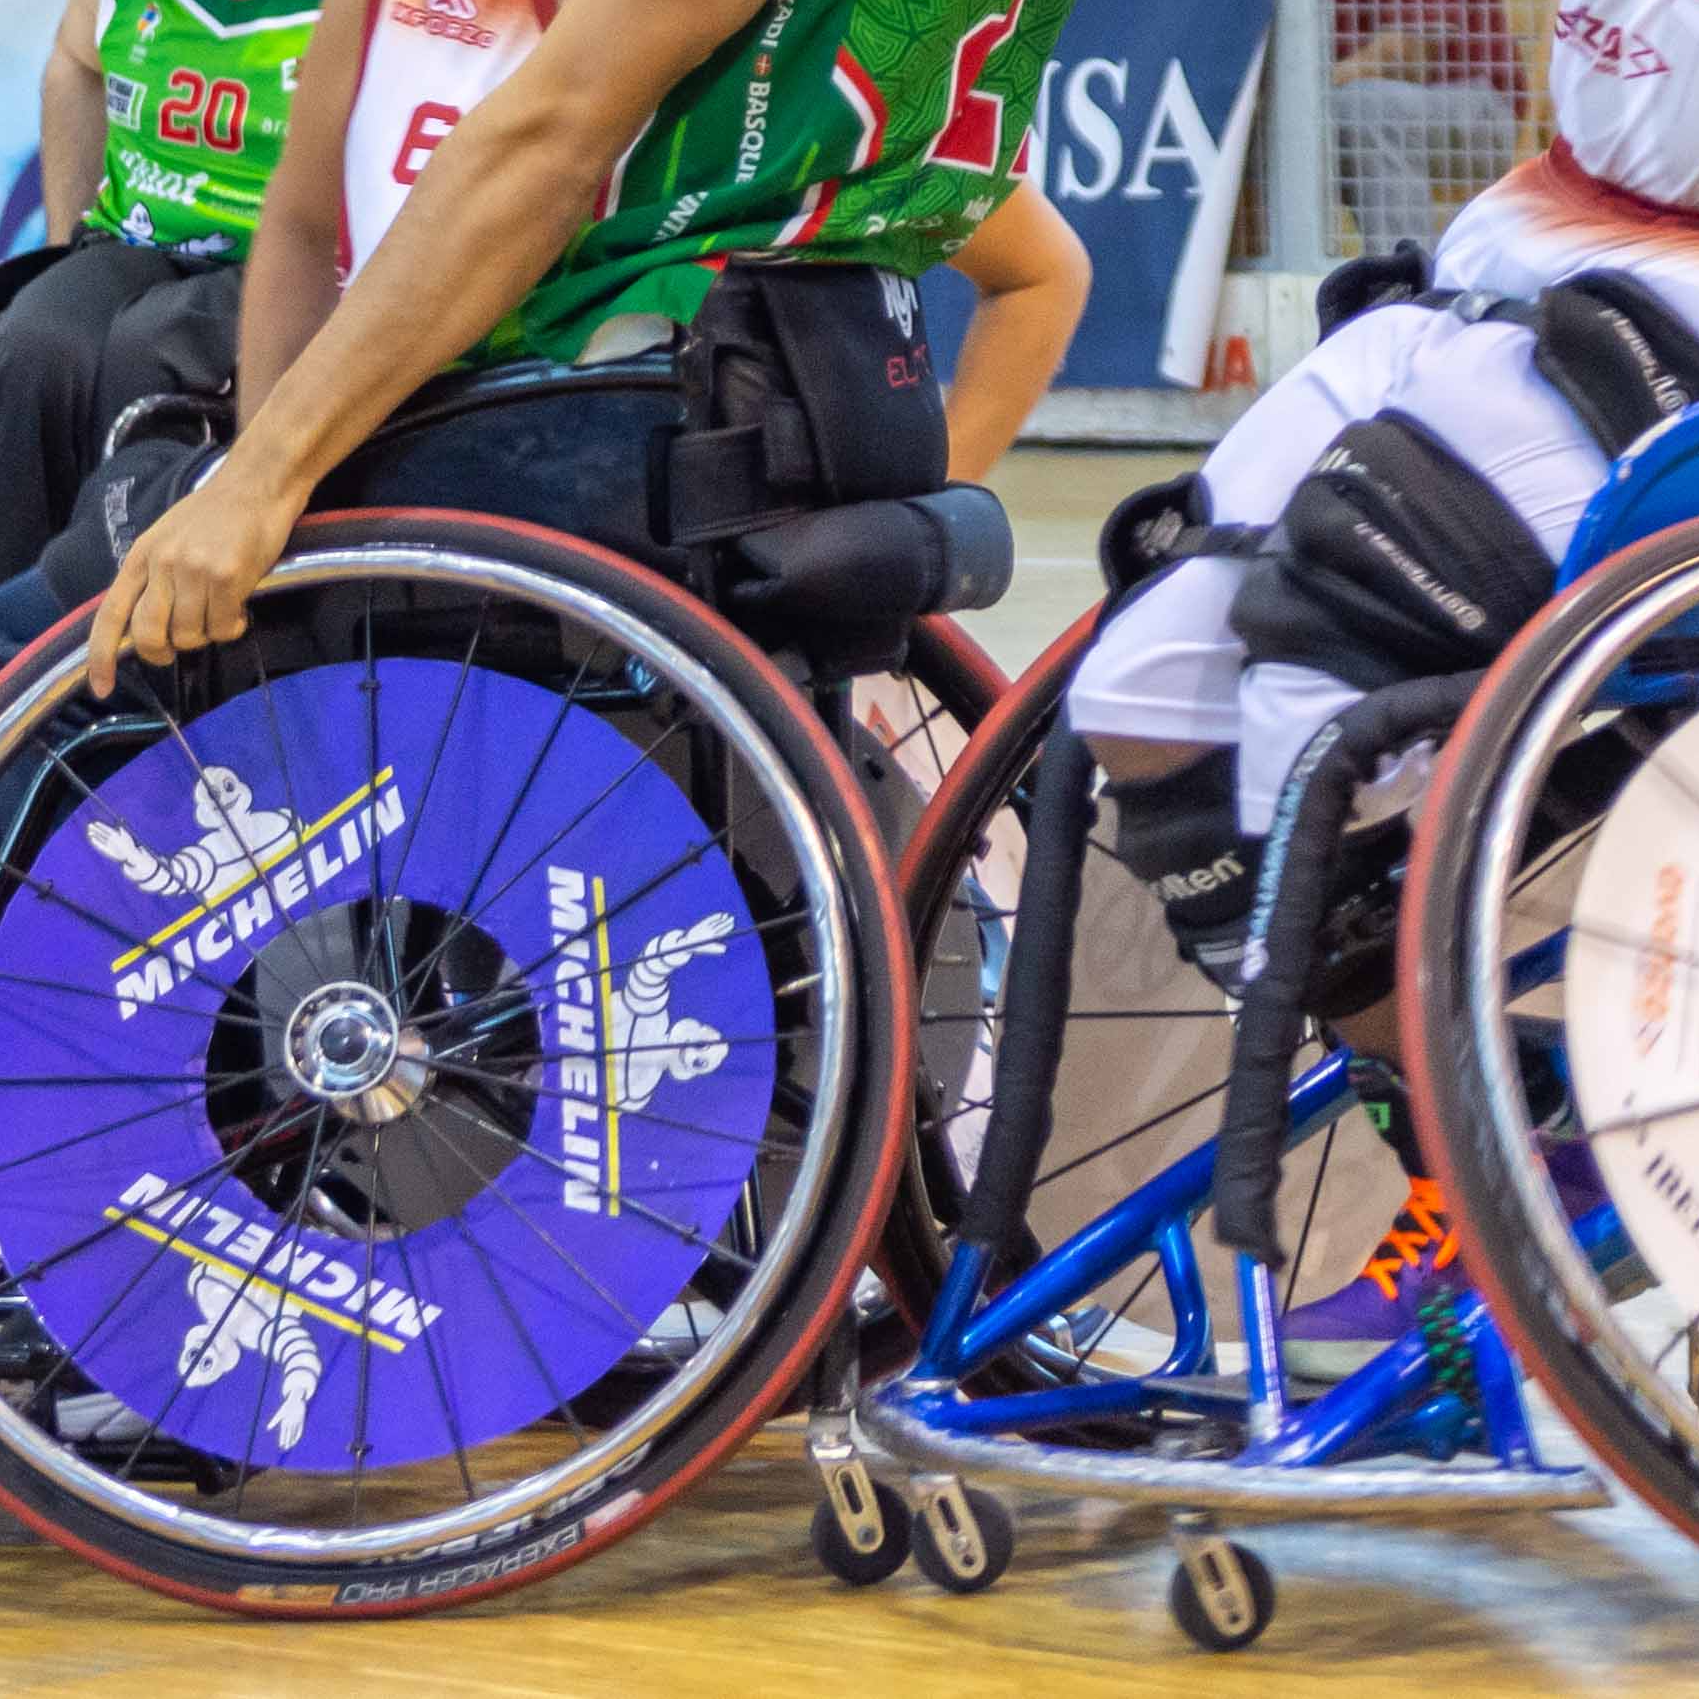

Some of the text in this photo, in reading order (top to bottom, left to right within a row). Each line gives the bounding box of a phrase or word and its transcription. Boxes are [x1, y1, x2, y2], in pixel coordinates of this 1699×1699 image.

[158, 67, 249, 153] 20
[111, 783, 409, 1020] MICHELIN
[546, 863, 601, 1213] MICHELIN
[118, 1171, 444, 1343] MICHELIN
